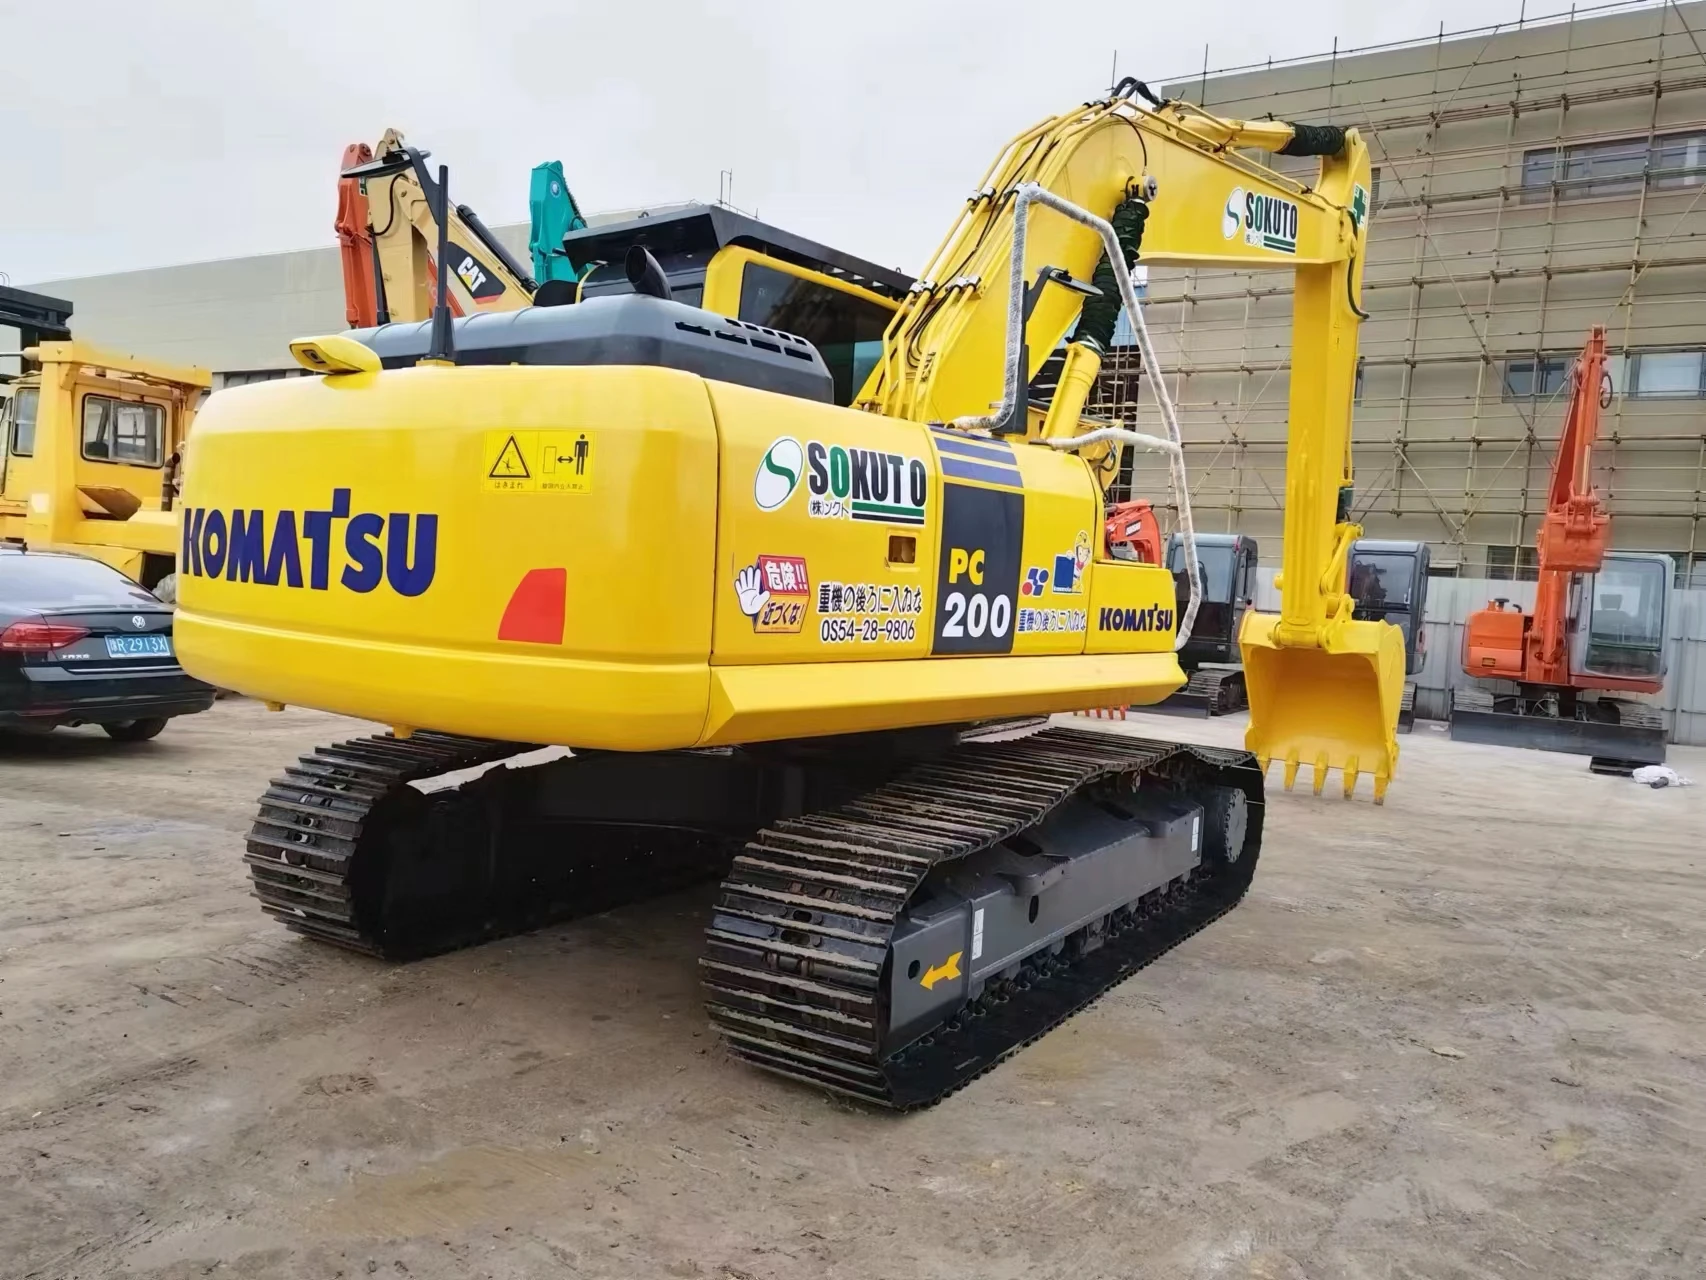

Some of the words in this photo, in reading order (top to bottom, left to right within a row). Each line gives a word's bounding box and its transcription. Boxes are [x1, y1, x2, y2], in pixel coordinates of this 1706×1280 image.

[1245, 191, 1298, 240] SOKUTO
[457, 256, 487, 293] CAT
[807, 442, 927, 508] SOKUTO
[183, 488, 439, 597] KOMATSU
[948, 547, 985, 586] PC
[942, 591, 1011, 638] 200
[1099, 603, 1173, 632] KOMATSU
